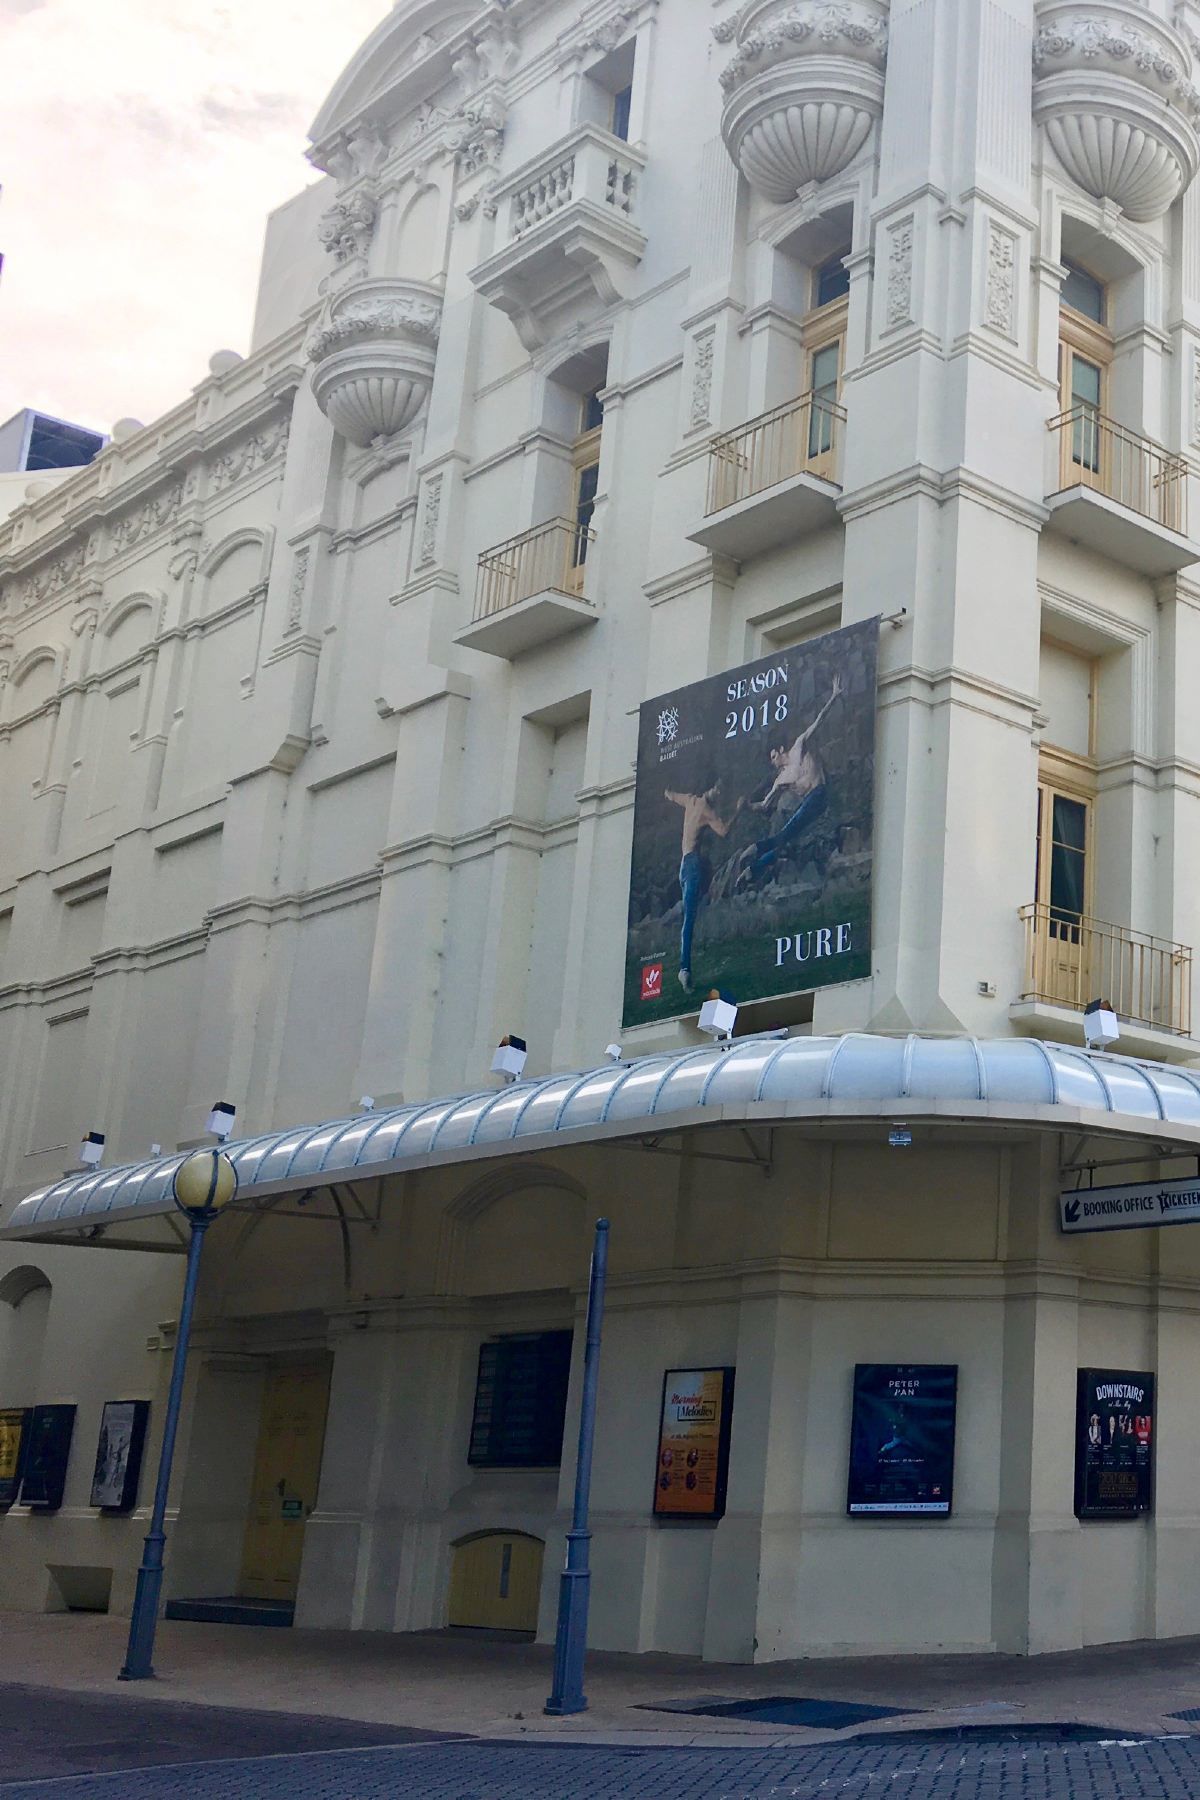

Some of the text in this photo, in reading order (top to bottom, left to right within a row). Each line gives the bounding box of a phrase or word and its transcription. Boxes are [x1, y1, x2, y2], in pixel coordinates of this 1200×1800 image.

[727, 664, 789, 702] SEASON
[725, 694, 788, 739] 2018
[775, 922, 852, 967] PURE
[1083, 1200, 1123, 1217] BOOKING
[1124, 1196, 1155, 1213] OFFICE
[889, 1380, 920, 1388] PETER
[894, 1388, 915, 1396] PAN
[1096, 1384, 1144, 1402] DOWNSTAIRS
[682, 1405, 713, 1417] Melodies
